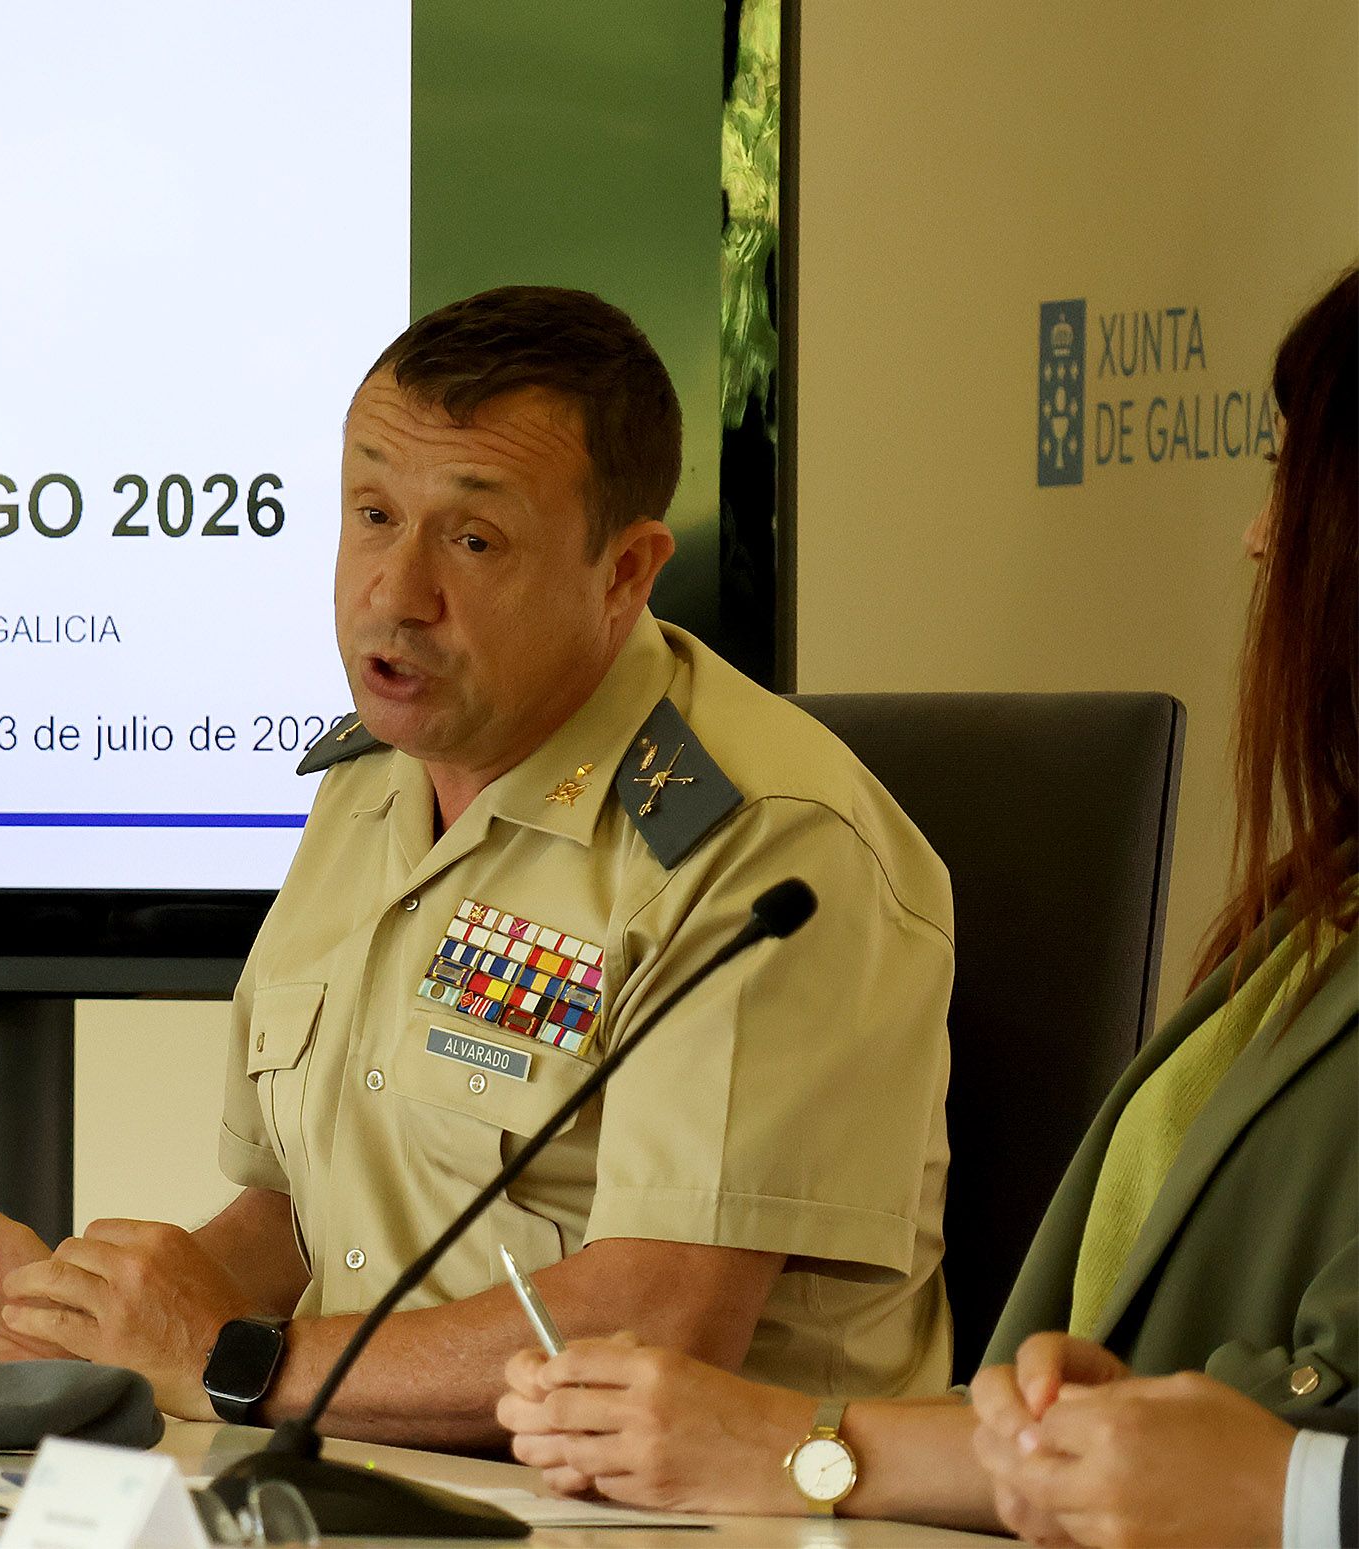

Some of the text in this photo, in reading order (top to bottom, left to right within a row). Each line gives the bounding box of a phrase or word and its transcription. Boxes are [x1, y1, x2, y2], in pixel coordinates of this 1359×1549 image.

[1098, 305, 1207, 379] XUNTA
[1095, 390, 1277, 466] DE GALICIA
[111, 473, 285, 538] 2026
[33, 715, 81, 751] de
[93, 715, 174, 760] julio
[189, 715, 237, 752] de
[443, 1038, 511, 1070] ALVARADO
